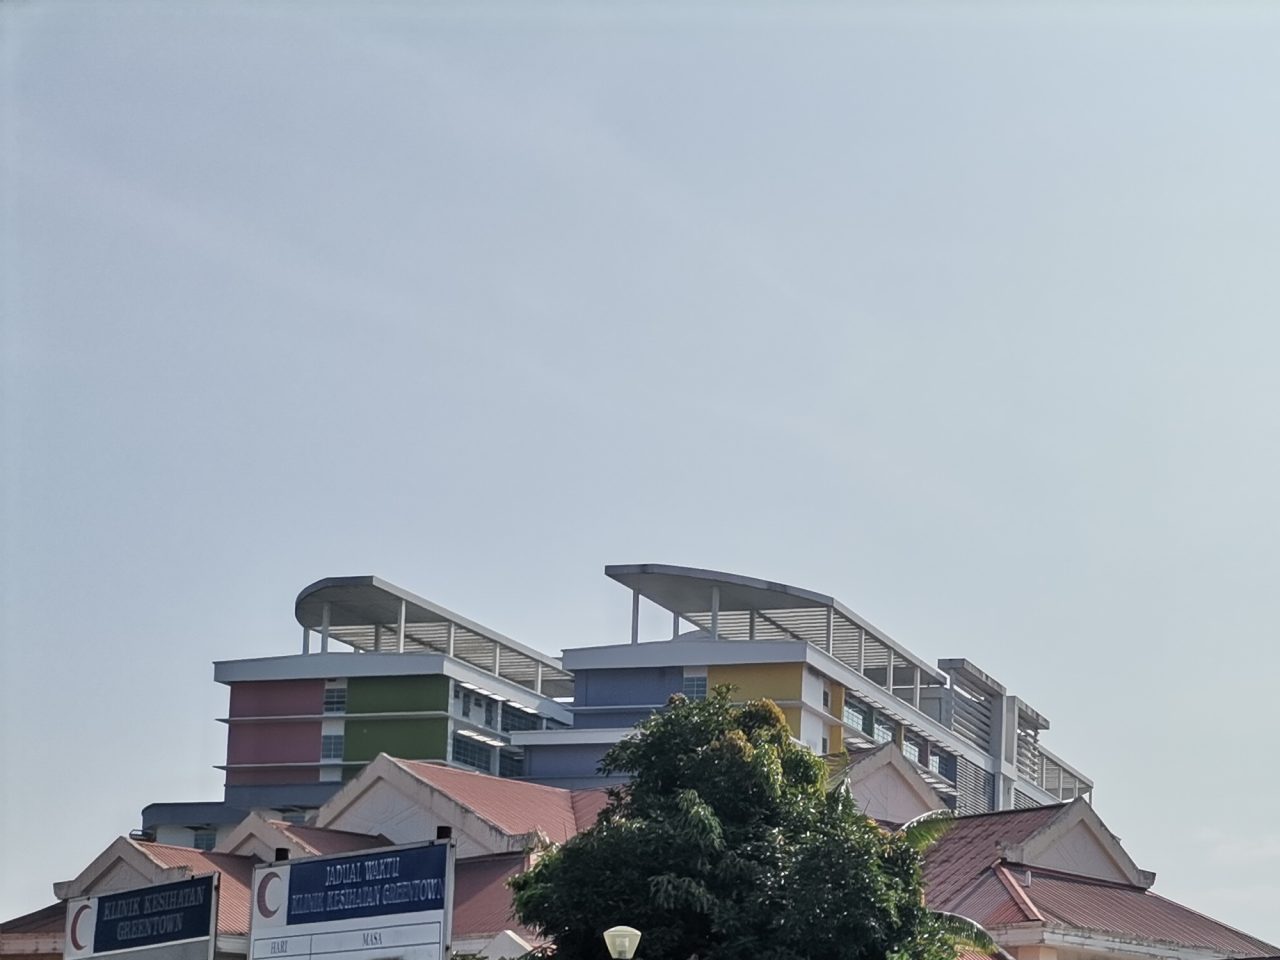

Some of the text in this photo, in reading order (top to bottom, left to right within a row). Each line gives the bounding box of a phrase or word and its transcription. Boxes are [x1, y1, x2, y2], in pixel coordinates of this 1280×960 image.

[325, 857, 400, 886] JADUAL WAKTU
[104, 885, 206, 920] KLINIK KESIHATAN
[291, 877, 445, 914] KLINIK KESIHATAN GREENTOWN
[117, 912, 184, 940] GREENTOWN
[362, 932, 383, 946] MASA
[270, 940, 288, 954] HARI
